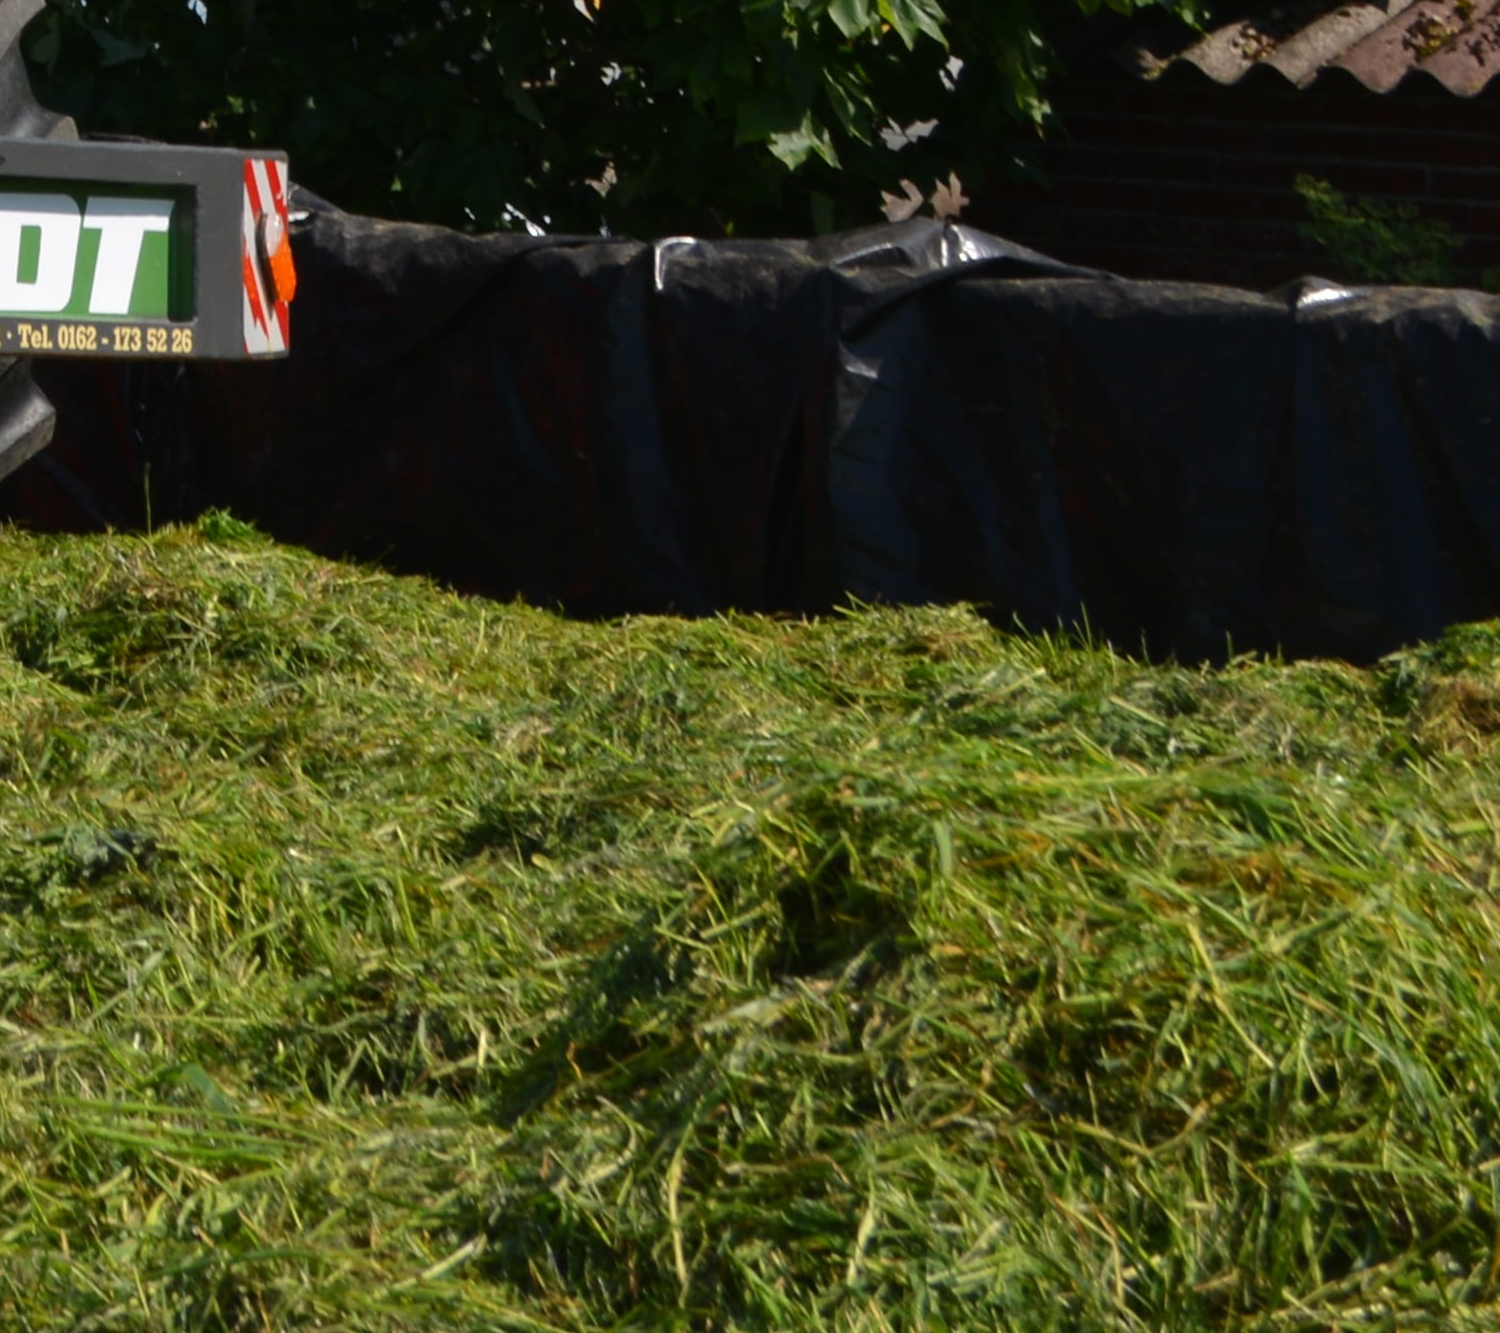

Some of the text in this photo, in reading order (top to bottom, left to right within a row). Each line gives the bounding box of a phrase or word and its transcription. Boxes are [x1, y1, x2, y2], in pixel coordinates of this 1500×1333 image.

[18, 324, 53, 349] Tel.
[57, 326, 97, 350] 0162
[113, 327, 141, 351] 173
[146, 329, 168, 352] 52
[171, 329, 193, 353] 26
